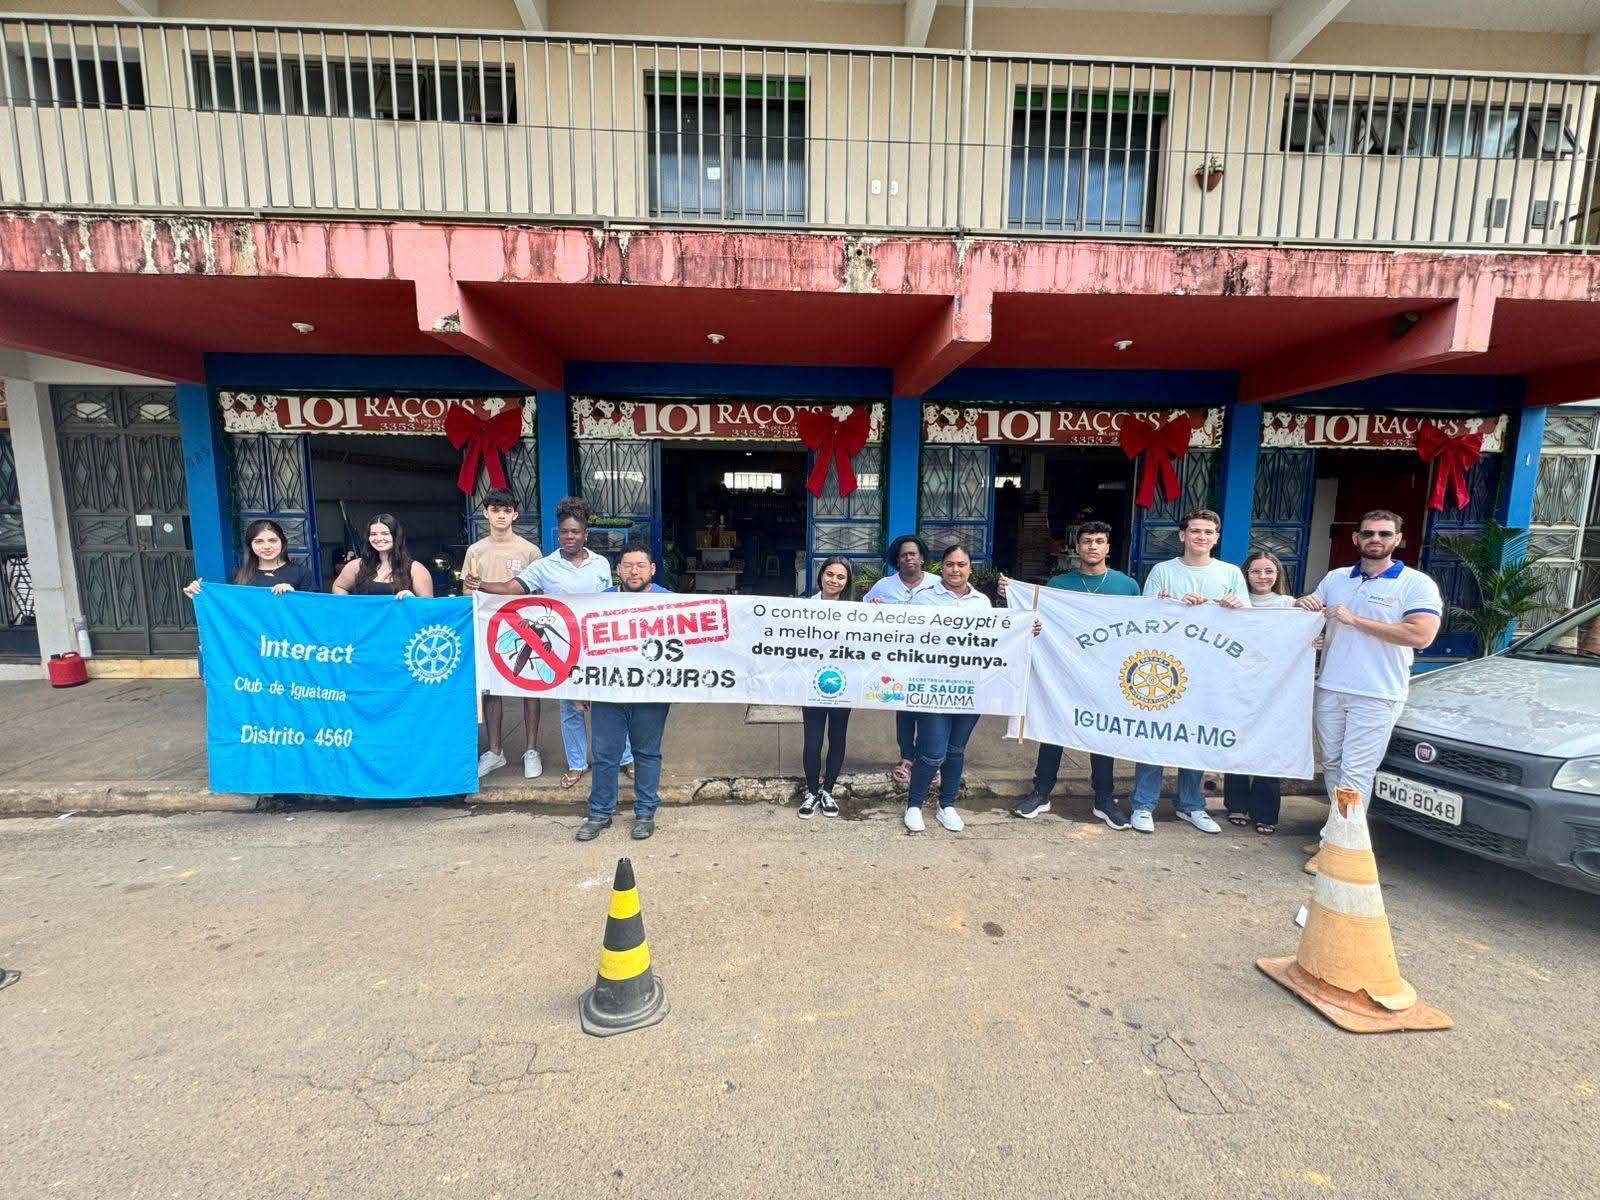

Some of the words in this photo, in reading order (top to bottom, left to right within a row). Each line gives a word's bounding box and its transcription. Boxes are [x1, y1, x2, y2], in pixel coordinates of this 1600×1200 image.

[283, 397, 363, 428] 101
[638, 402, 715, 435] 101
[981, 410, 1054, 442] 101
[1309, 414, 1370, 444] 101
[592, 612, 719, 644] ELIMINE
[754, 604, 766, 617] O
[771, 607, 841, 622] controle
[847, 610, 868, 622] do
[872, 610, 926, 626] Aedes
[930, 614, 998, 632] Aegypti
[1002, 617, 1011, 629] é
[260, 634, 355, 664] Interact
[641, 638, 684, 662] OS
[764, 627, 773, 636] a
[780, 626, 839, 640] melhor
[846, 630, 914, 644] maneira
[920, 631, 941, 644] de
[946, 632, 998, 647] evitar
[1076, 620, 1180, 650] ROTARY
[1184, 624, 1245, 660] CLUB
[752, 642, 824, 660] dengue,
[829, 647, 866, 661] zika
[871, 650, 882, 661] e
[886, 649, 1008, 669] chikungunya.
[234, 676, 263, 692] Club
[269, 680, 284, 695] de
[291, 682, 346, 702] Iguatama
[568, 666, 736, 688] CRIADOUROS
[908, 684, 925, 692] DE
[906, 692, 975, 707] IGUATAMA
[240, 724, 305, 746] Distrito
[314, 728, 352, 747] 4560
[1074, 708, 1237, 748] IGUATAMA-MG
